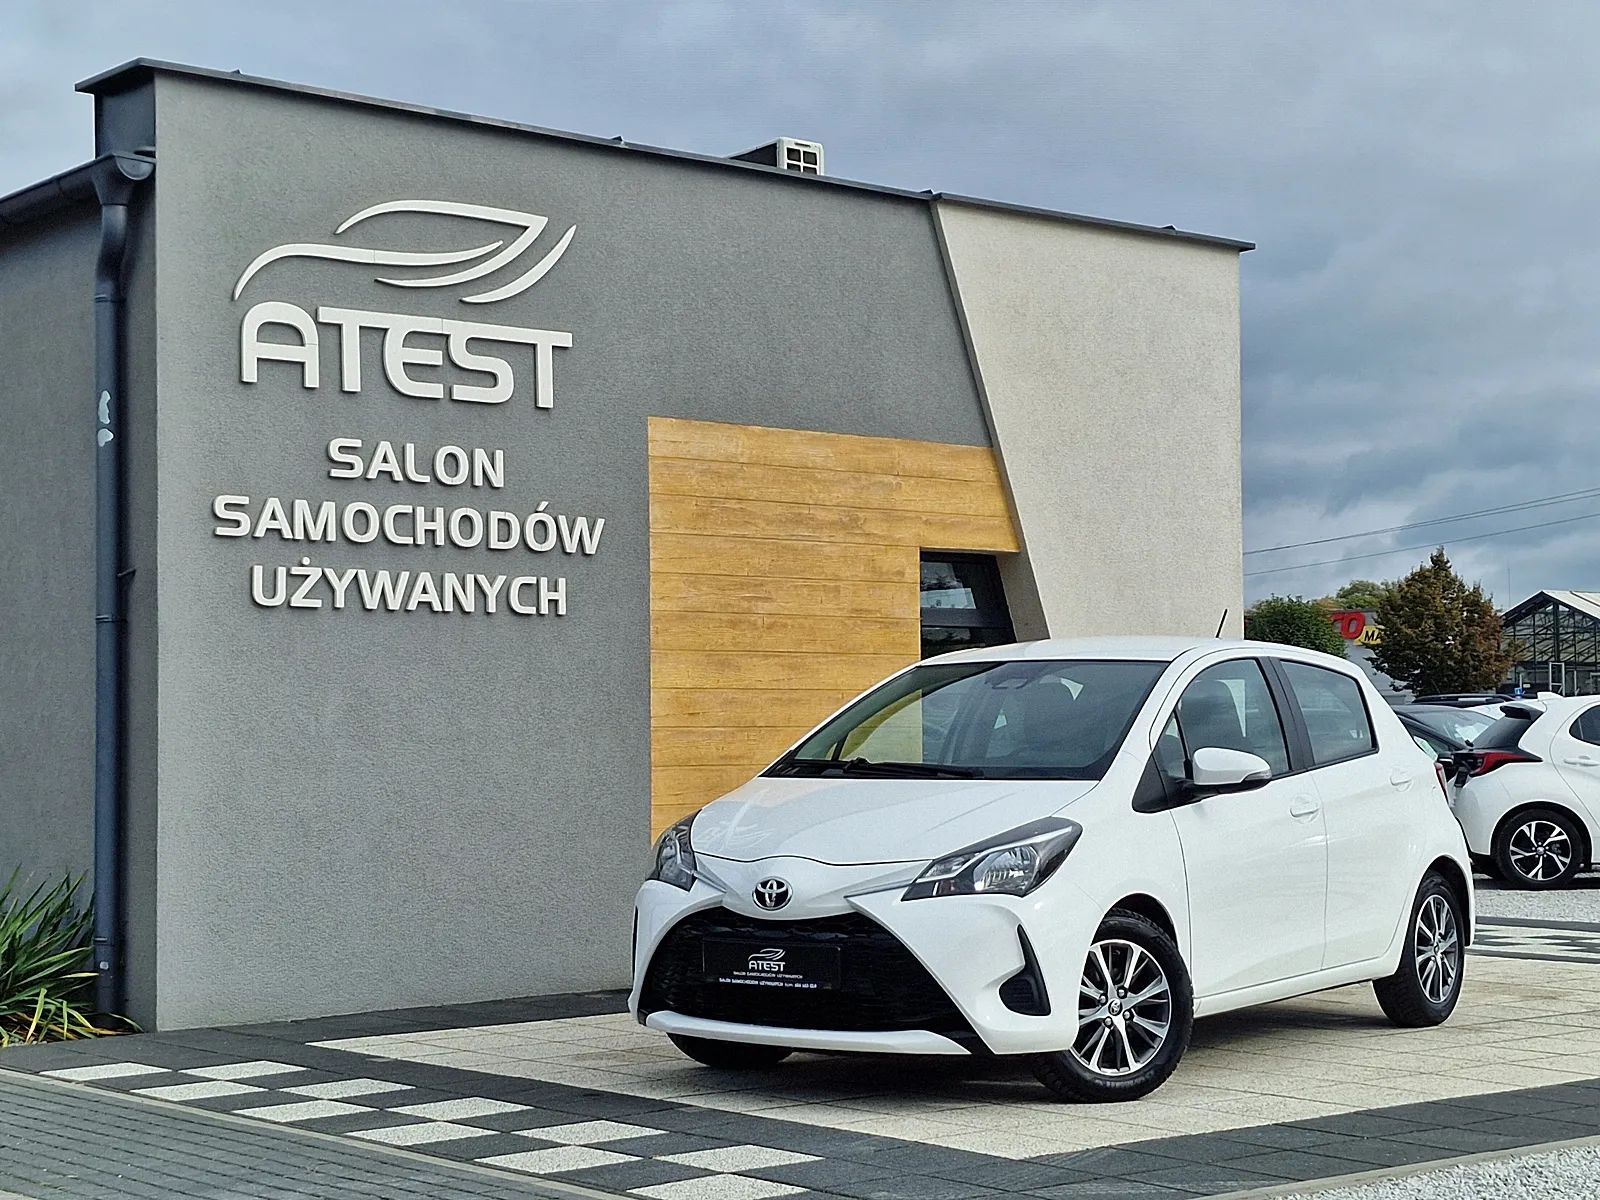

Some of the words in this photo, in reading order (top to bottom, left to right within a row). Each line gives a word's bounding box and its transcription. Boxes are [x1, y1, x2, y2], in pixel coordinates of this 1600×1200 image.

[240, 301, 573, 409] ATEST
[328, 437, 505, 488] SALON
[212, 494, 606, 555] SAMOCHODÓW
[250, 556, 568, 616] UŻYWANYCH
[748, 960, 786, 972] ATEST
